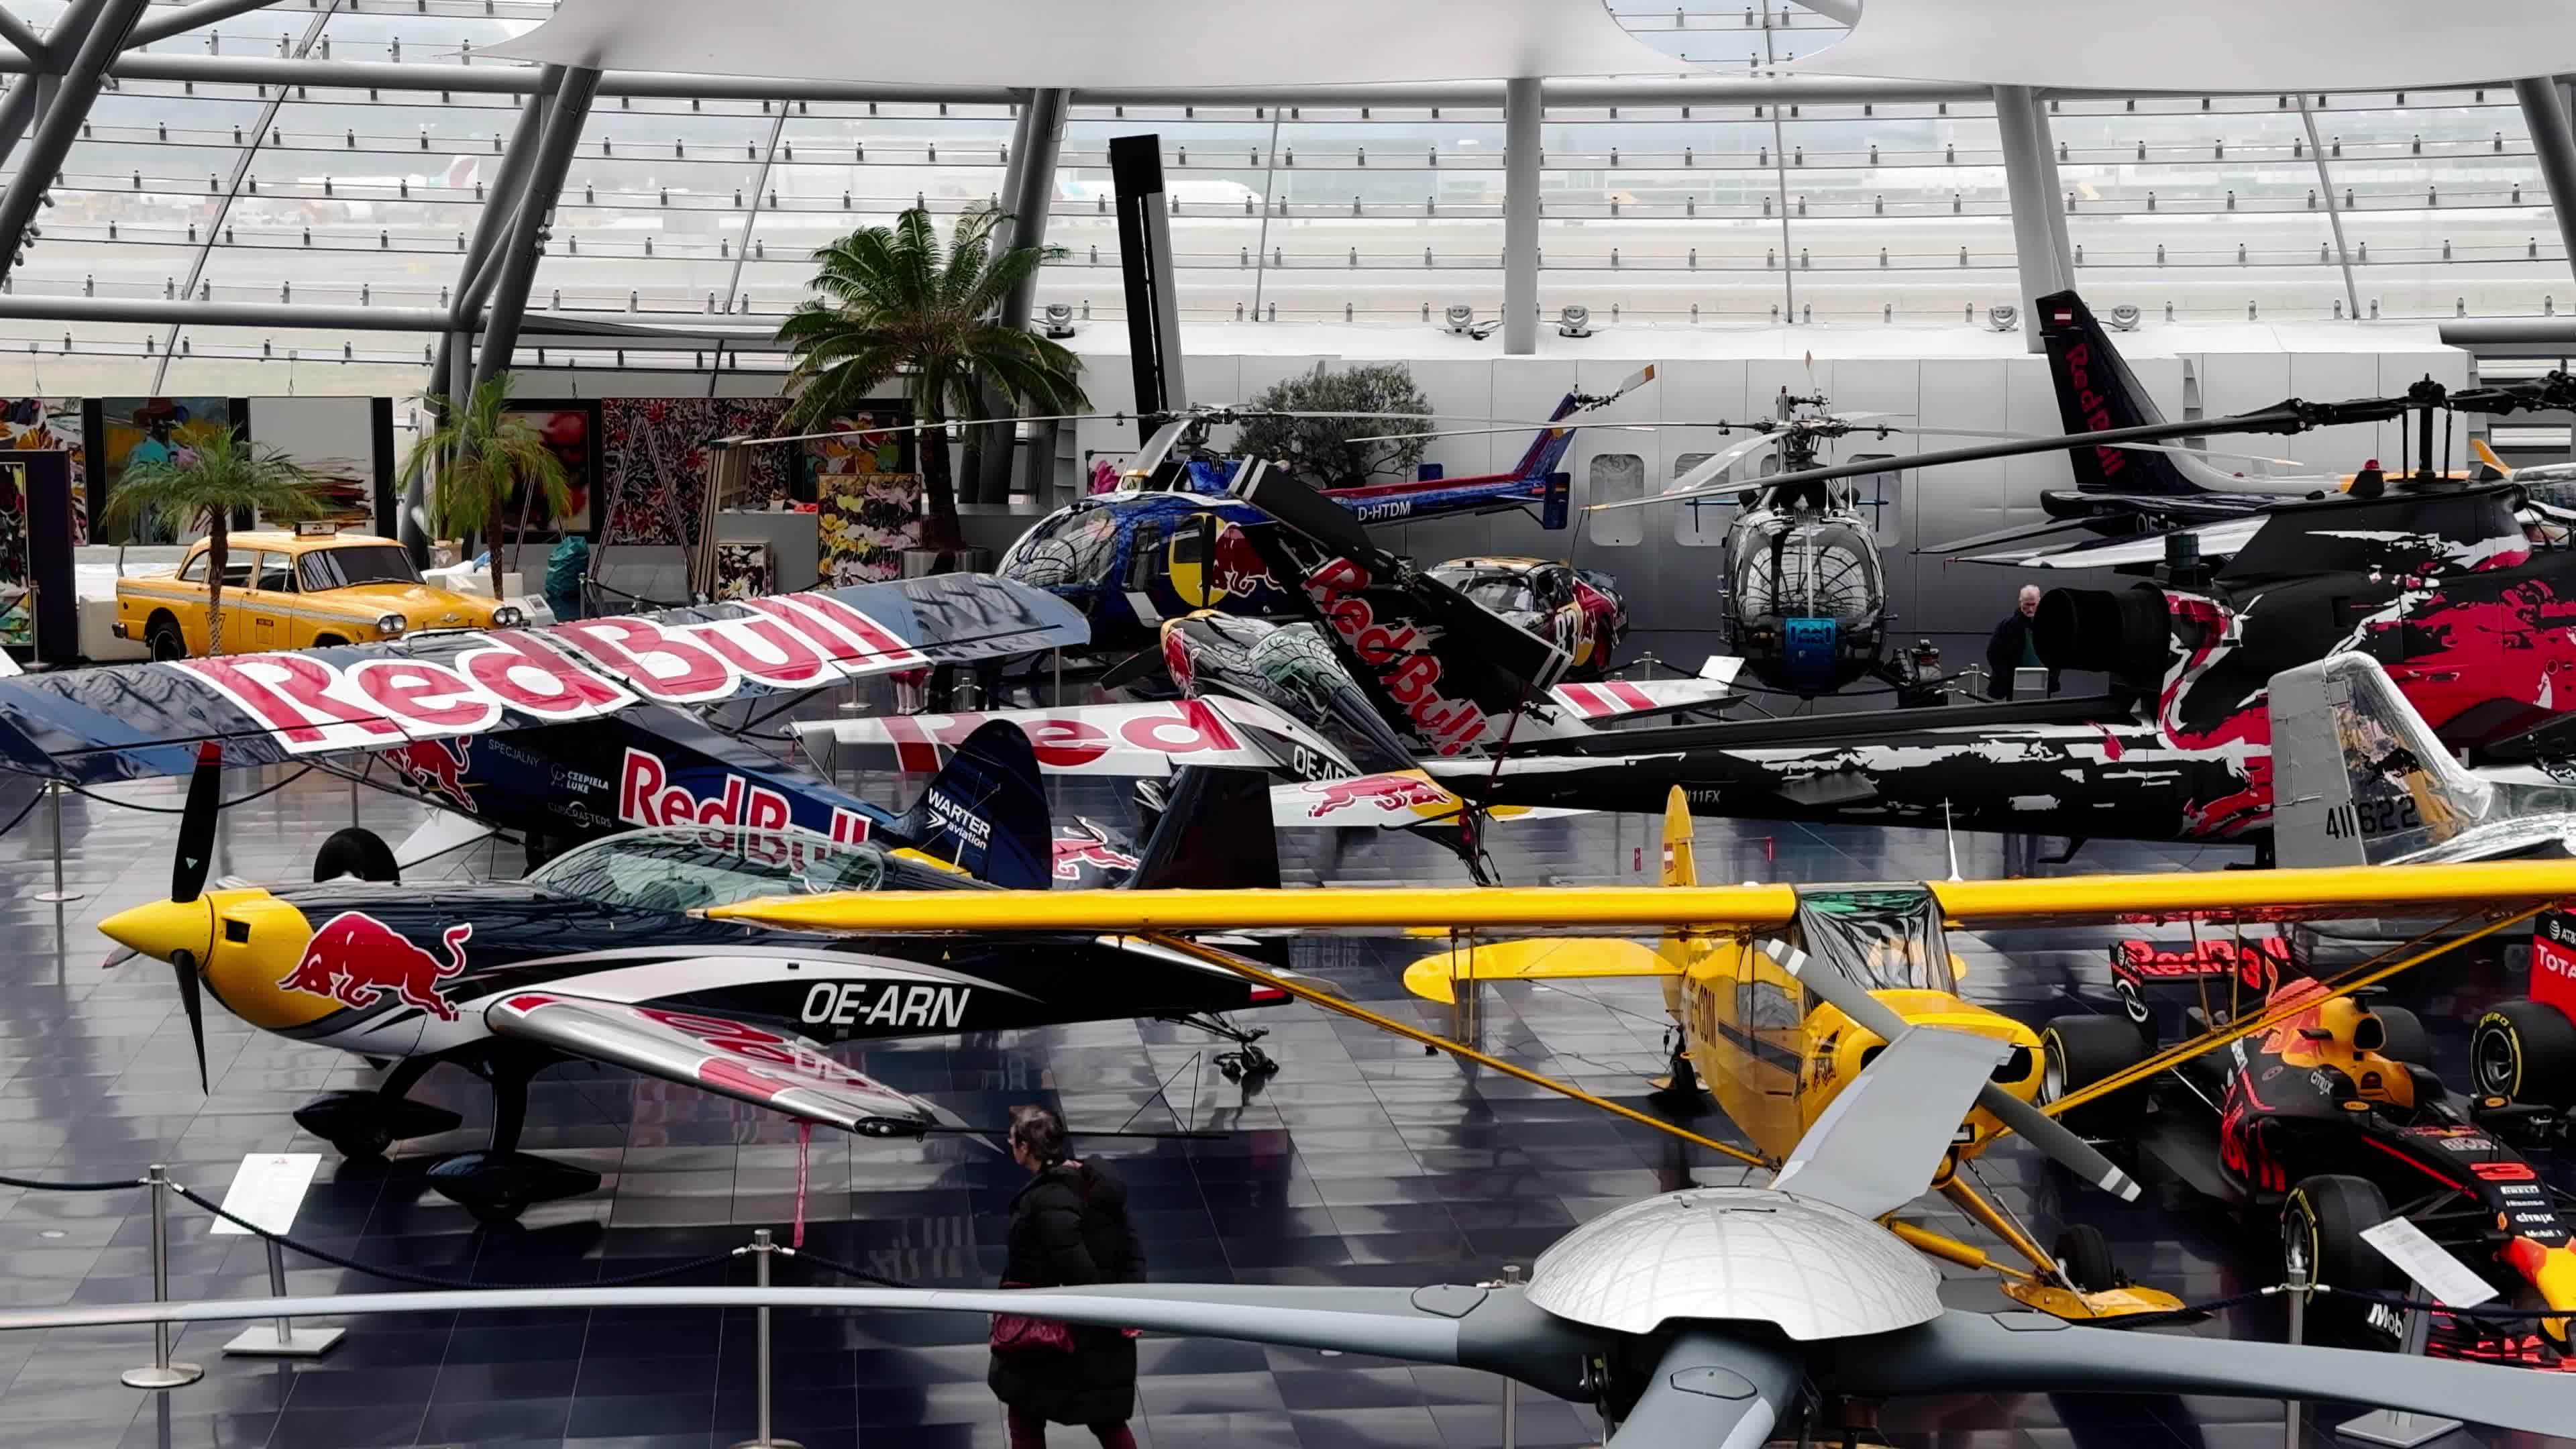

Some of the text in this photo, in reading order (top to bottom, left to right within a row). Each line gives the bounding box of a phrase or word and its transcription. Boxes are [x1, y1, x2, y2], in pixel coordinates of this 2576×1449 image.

[2066, 343, 2104, 413] Red
[1357, 500, 1411, 521] D-HTDM
[178, 590, 915, 746] Red Bull
[1300, 558, 1487, 757] Red Bull
[488, 739, 540, 768] SPECJALNY
[566, 781, 589, 794] LUKE
[620, 747, 745, 847] Red
[928, 787, 991, 840] WARTER
[947, 821, 987, 851] aviation
[801, 982, 971, 1028] OE-ARN
[2367, 1303, 2404, 1340] Mob
